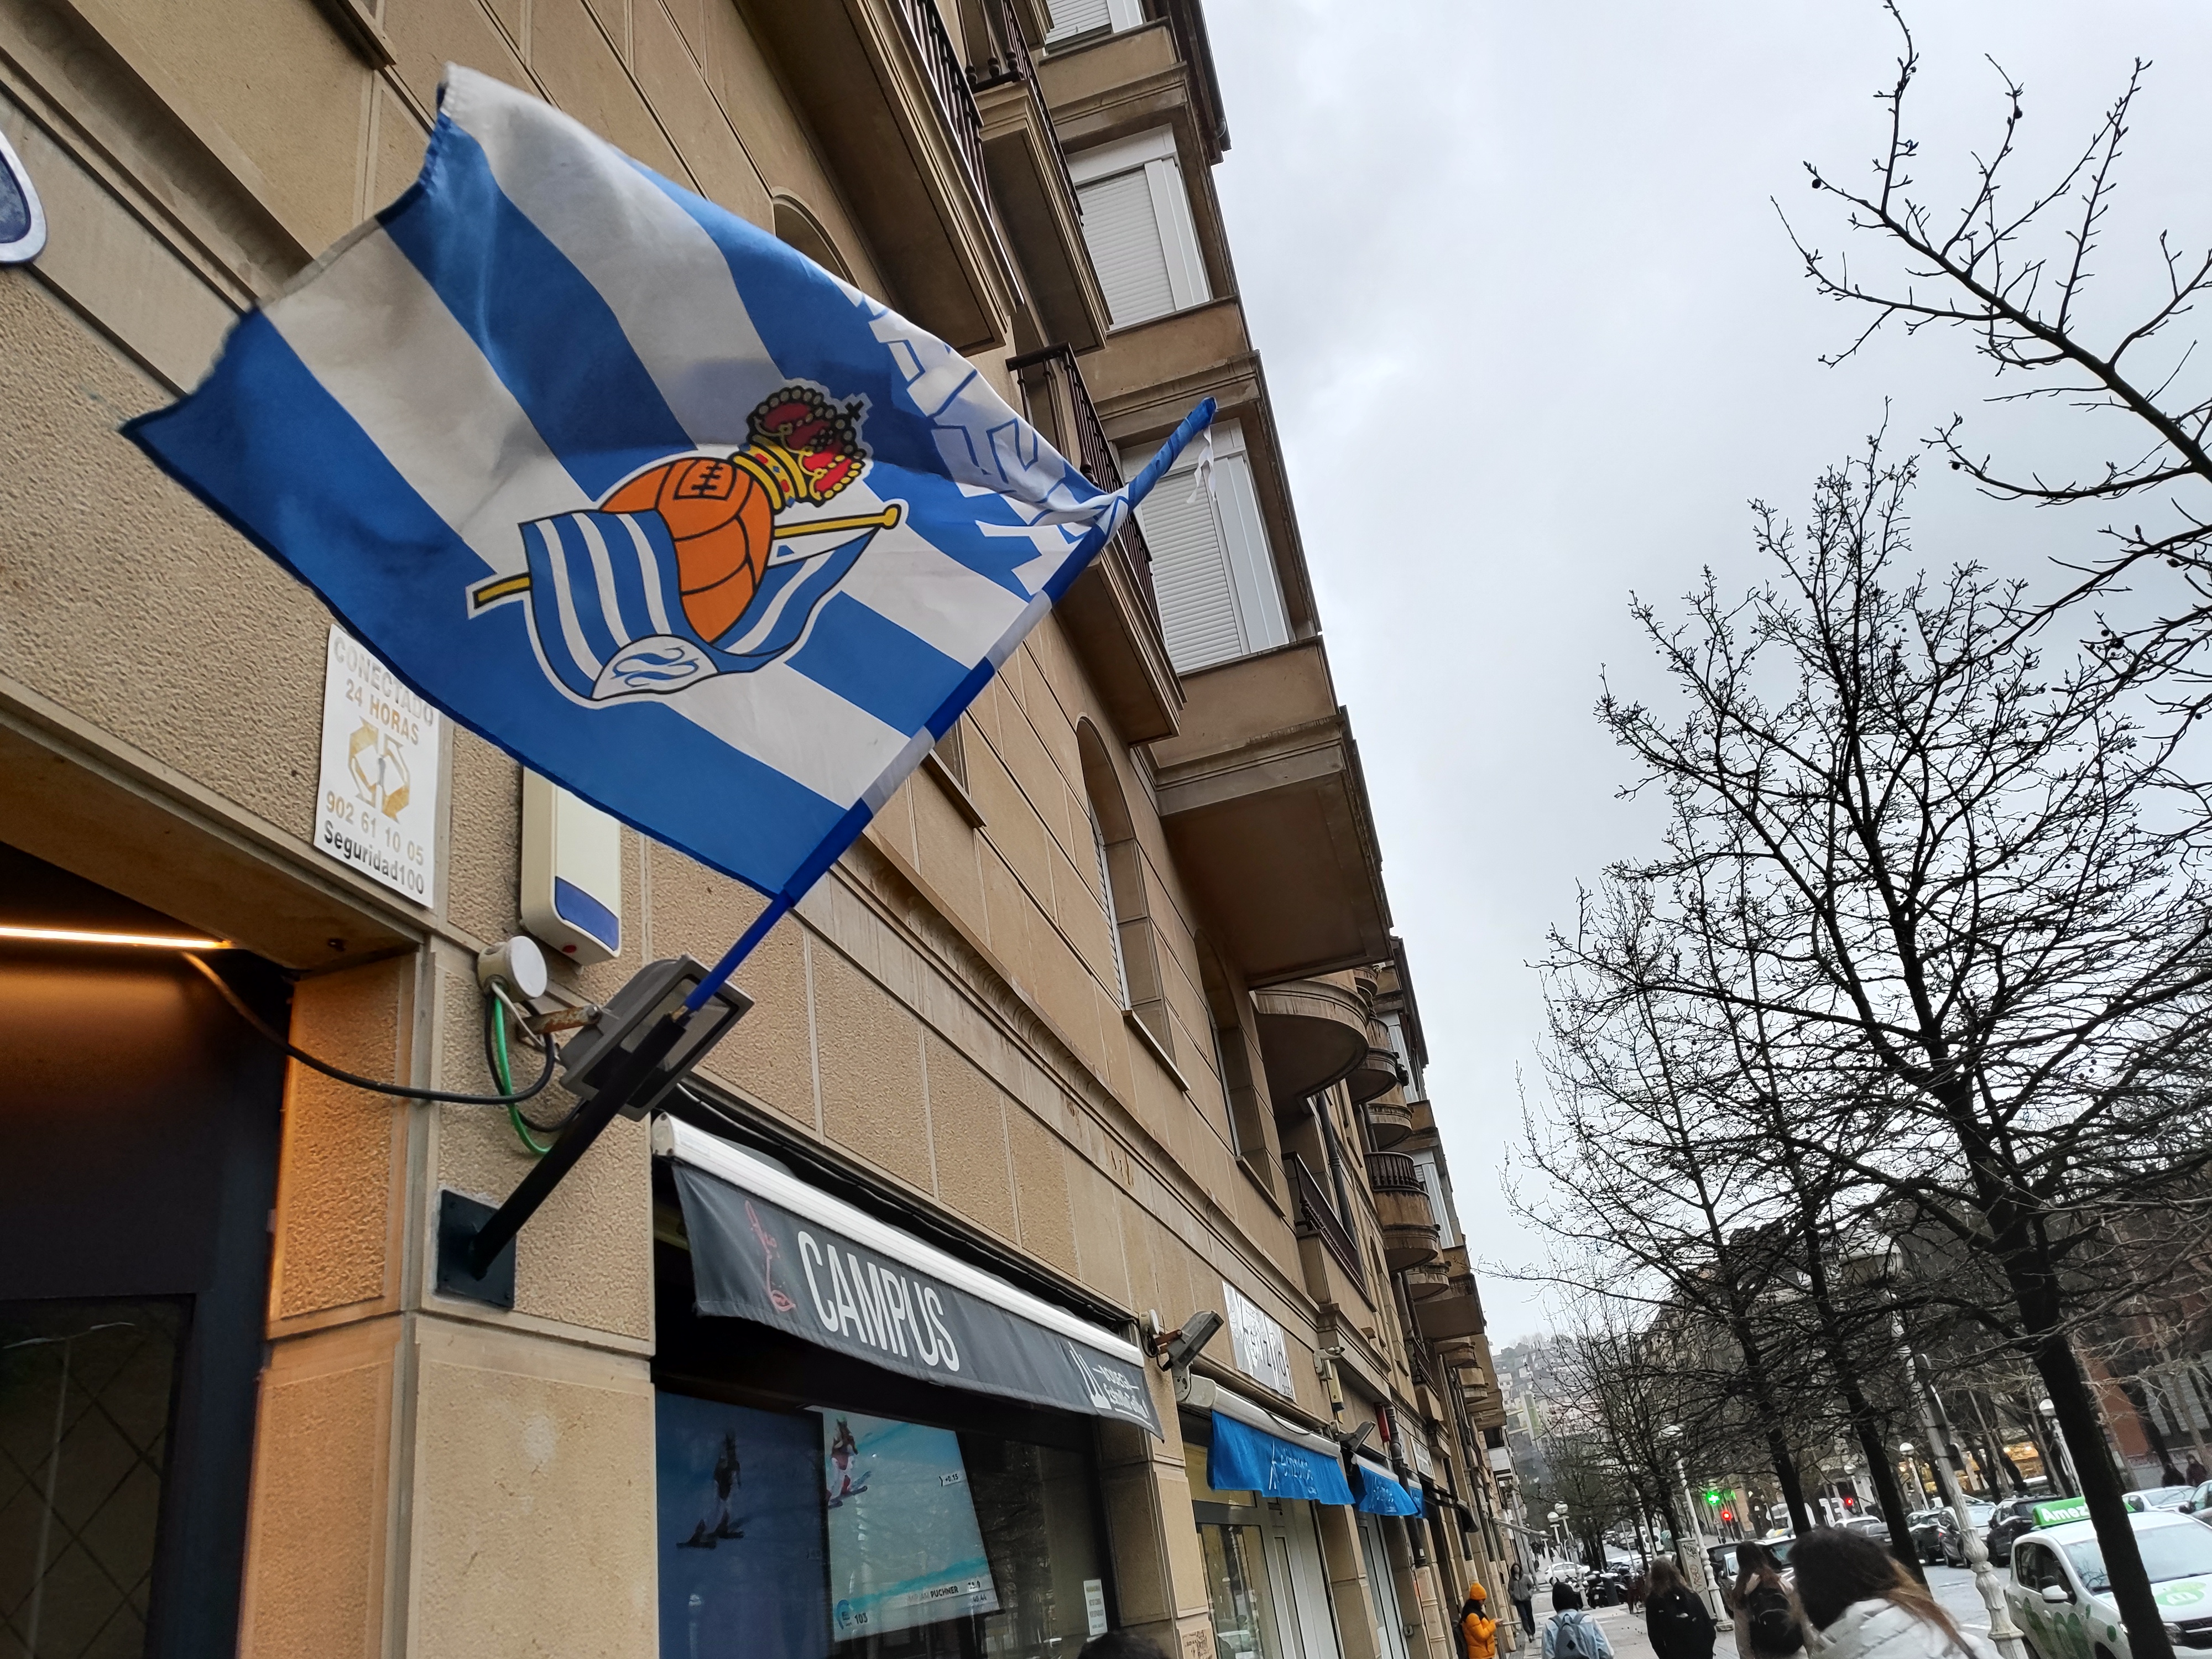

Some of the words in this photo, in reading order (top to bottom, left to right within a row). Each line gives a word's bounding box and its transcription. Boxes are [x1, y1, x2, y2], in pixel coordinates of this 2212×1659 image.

[333, 636, 434, 727] CONECTADO
[345, 677, 363, 707] 24
[369, 693, 419, 745] HORAS
[324, 820, 424, 895] Seguridad100
[326, 790, 354, 825] 902
[361, 811, 377, 843] 61
[385, 827, 401, 853] 10
[406, 840, 424, 867] 05
[797, 1230, 960, 1372] CAMPUS
[854, 1613, 868, 1625] 103
[930, 1585, 959, 1598] PUCHNER
